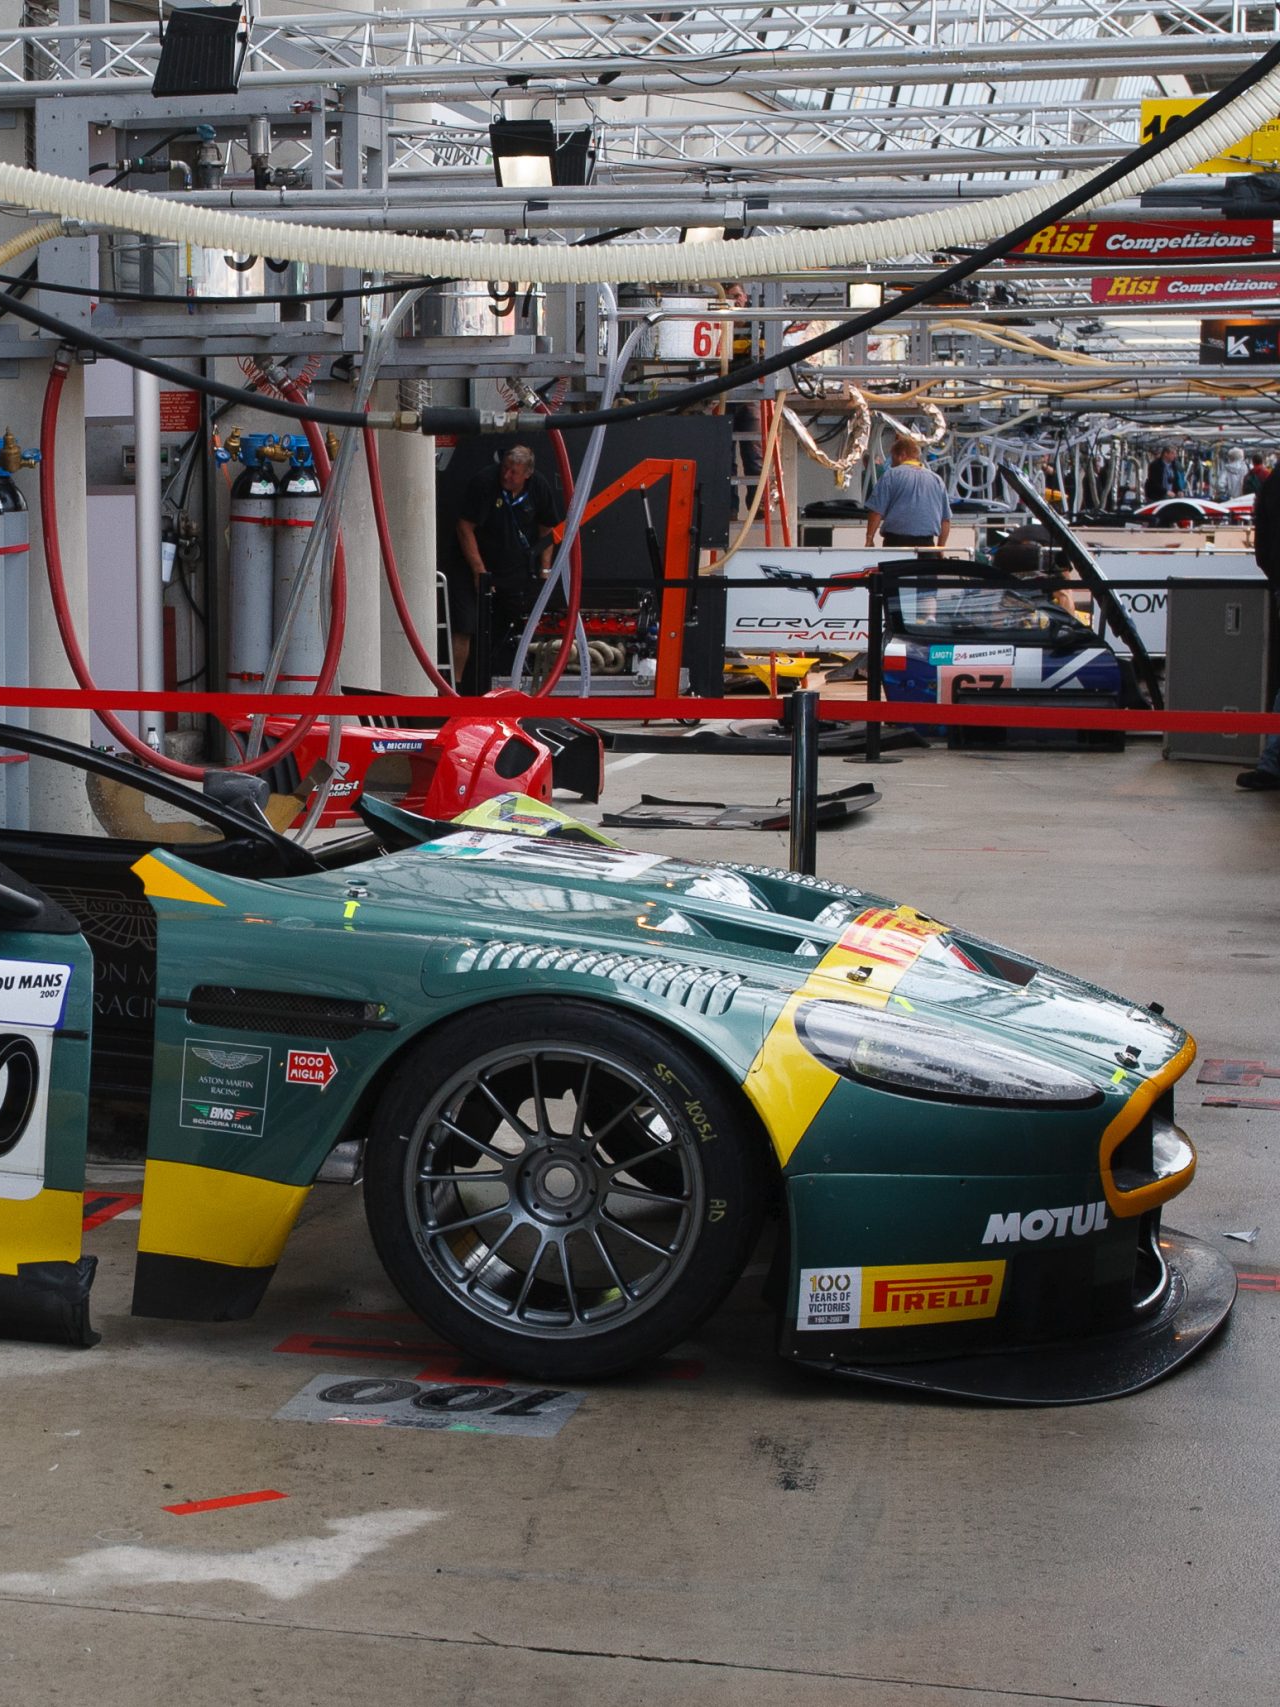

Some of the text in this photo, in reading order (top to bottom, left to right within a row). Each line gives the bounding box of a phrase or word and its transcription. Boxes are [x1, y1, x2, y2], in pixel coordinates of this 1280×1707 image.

[1024, 224, 1255, 254] Risi Competizione
[1107, 276, 1277, 296] Risi Competizione
[736, 617, 869, 628] CORVET
[787, 631, 869, 640] RACIN
[386, 742, 422, 750] MICHELIN
[18, 973, 63, 990] MANS
[39, 989, 60, 999] 2007
[294, 1056, 324, 1067] 1000
[290, 1069, 324, 1080] MIGLIA
[198, 1075, 254, 1088] ASTON MARTIN
[210, 1087, 240, 1097] RACING
[209, 1107, 235, 1121] BMS
[192, 1118, 252, 1131] SCUDERIA ITALIA
[981, 1201, 1109, 1244] MOTUL
[810, 1275, 850, 1292] 100
[809, 1292, 851, 1302] YEARS OF
[873, 1274, 993, 1312] PIRELLI
[809, 1303, 850, 1312] VICTORIES
